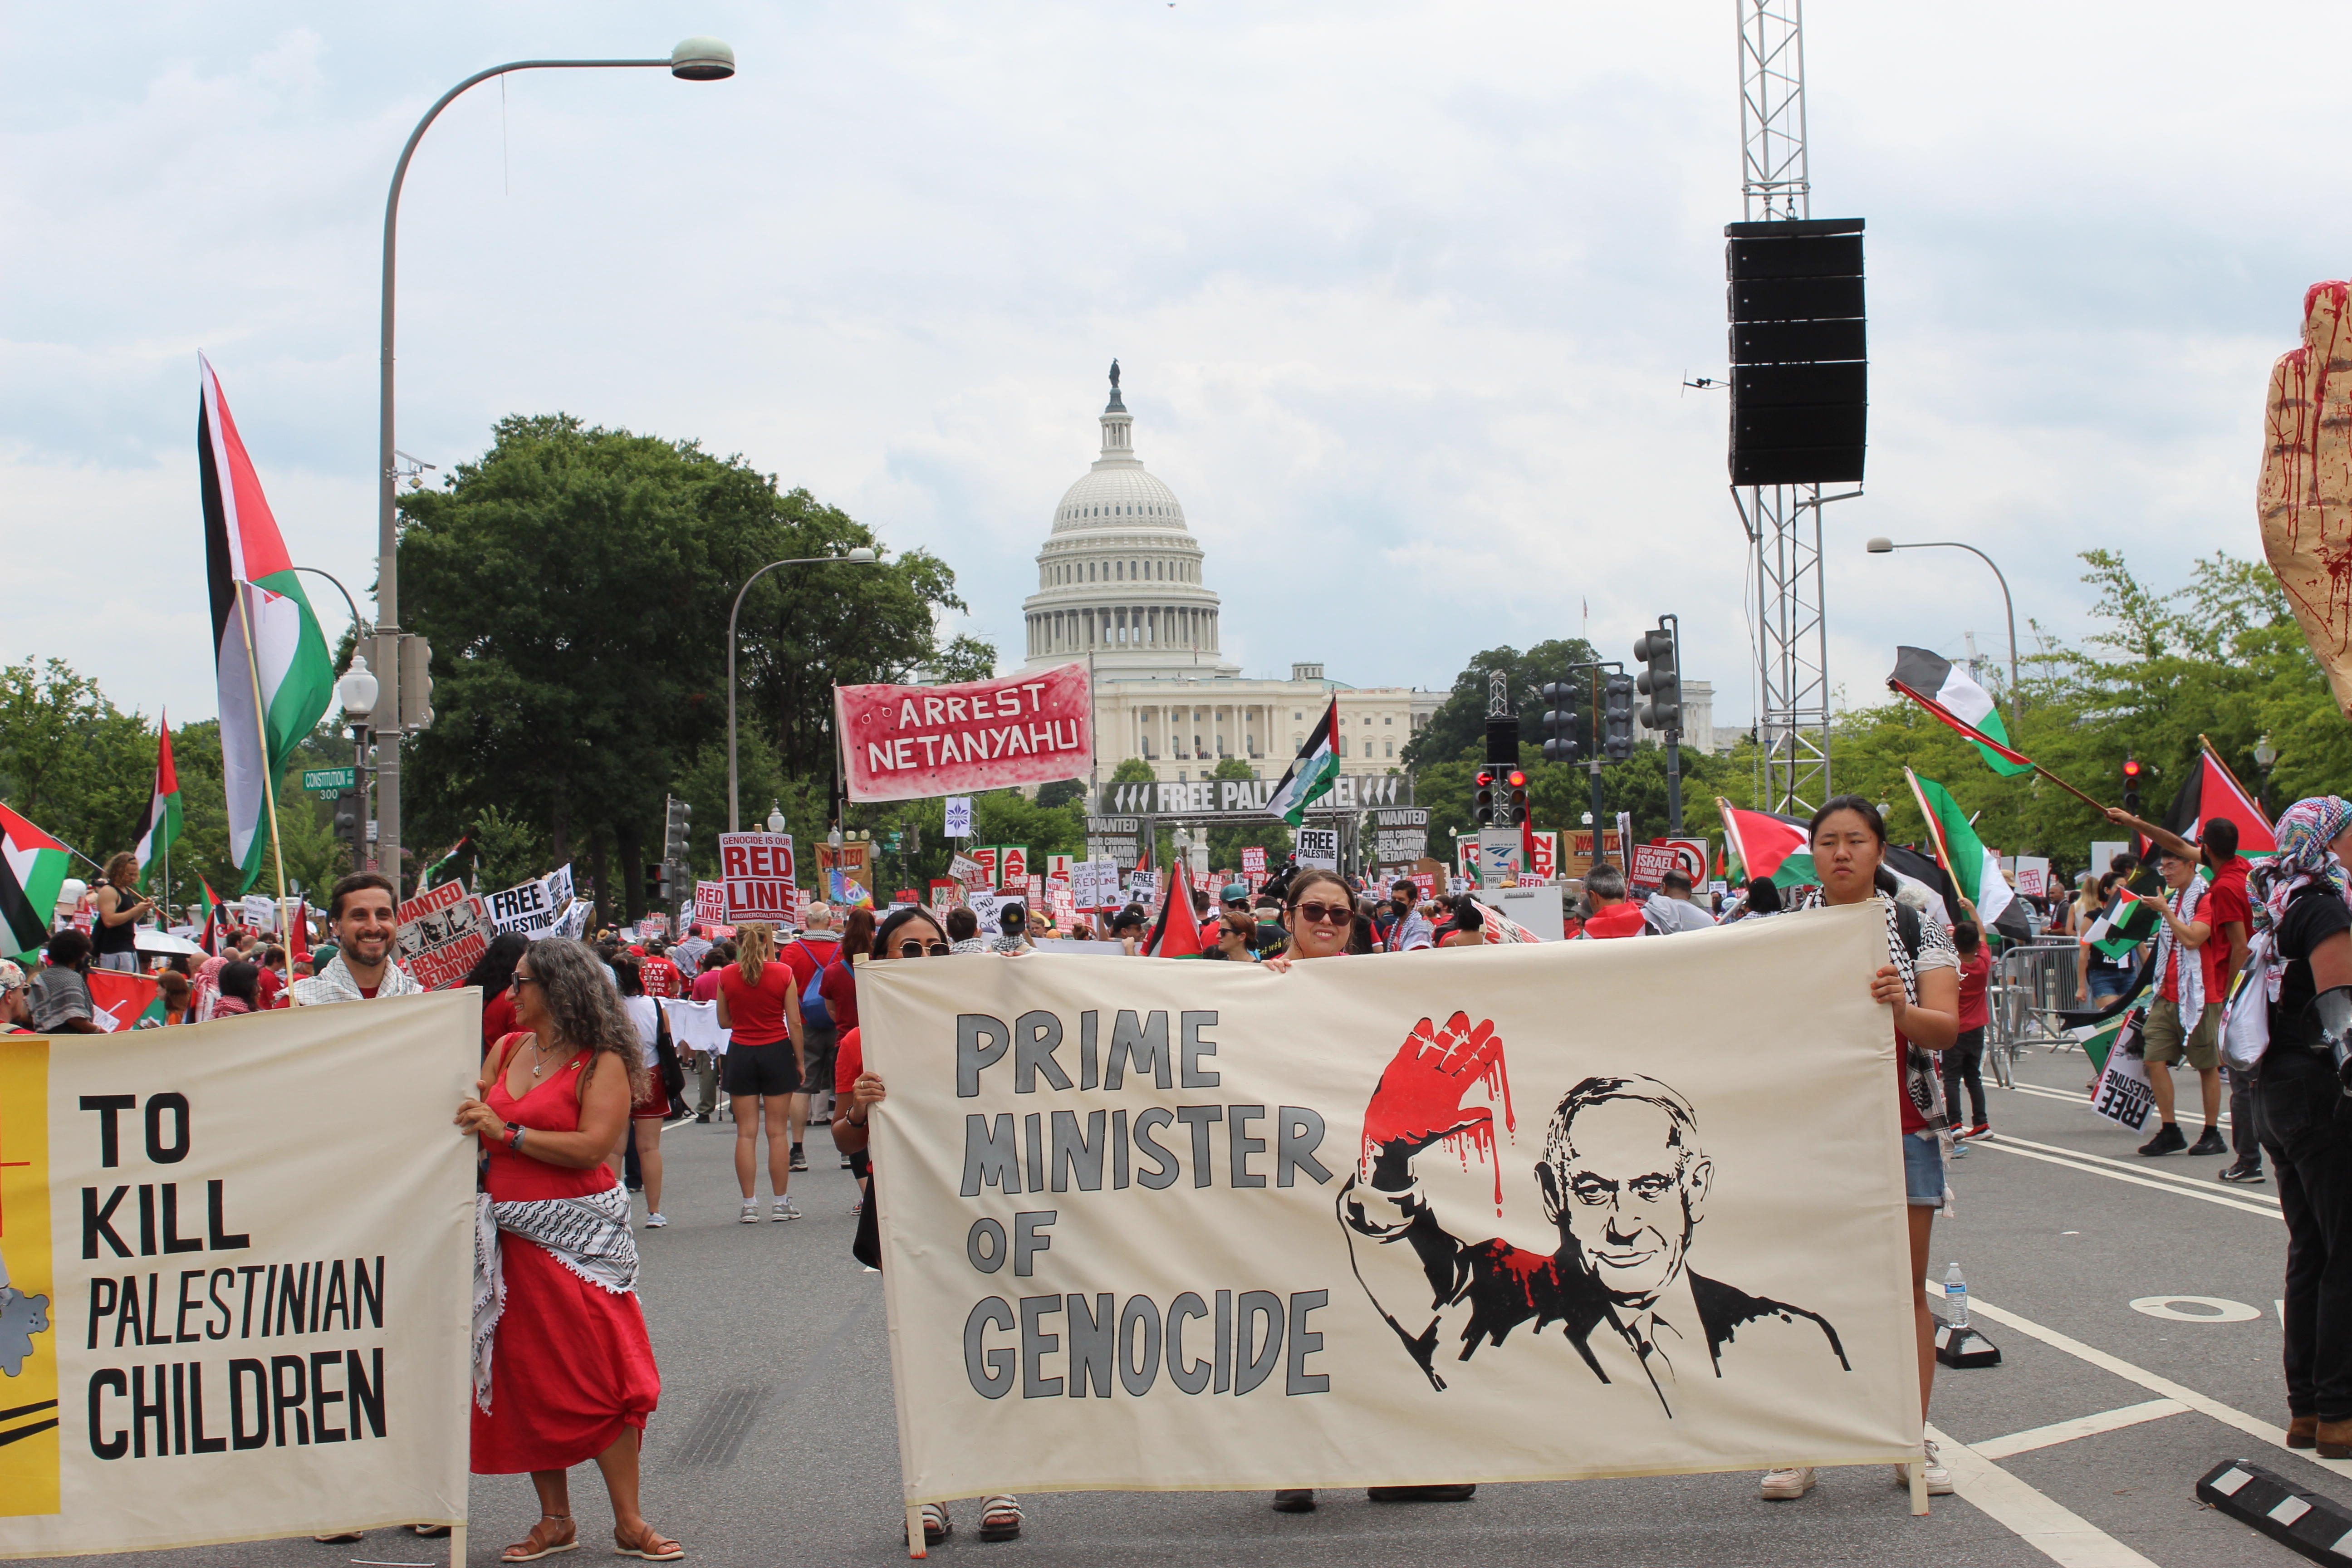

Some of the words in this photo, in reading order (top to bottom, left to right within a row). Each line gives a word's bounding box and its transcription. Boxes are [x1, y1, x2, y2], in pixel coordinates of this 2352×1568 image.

[899, 683, 1045, 730] ARREST
[868, 718, 1079, 773] NETANYAHU
[305, 771, 346, 788] CONSTITUTION
[319, 789, 338, 800] 300
[1157, 782, 1215, 812] FREE
[1377, 810, 1427, 826] WANTED
[1087, 818, 1138, 833] WANTED
[1301, 831, 1333, 850] FREE
[1378, 830, 1394, 839] WAR
[1395, 829, 1426, 839] CRIMINAL
[723, 836, 763, 845] GENOCIDE
[775, 837, 790, 847] OUR
[1104, 837, 1137, 846] CRIMINAL
[1378, 839, 1426, 852] BENJAMIN
[1298, 848, 1335, 859] PALESTINE
[1378, 850, 1425, 862] NETANYAHU
[1653, 849, 1676, 858] ARMING
[724, 846, 792, 877] RED
[1243, 858, 1264, 867] GAZA
[1636, 854, 1673, 870] ISRAEL
[1133, 872, 1154, 883] FREE
[1195, 872, 1209, 882] END
[1210, 874, 1223, 884] ALL
[1633, 874, 1662, 883] COMMUNIT
[1640, 867, 1657, 876] FUND
[547, 872, 561, 892] WITH
[1014, 876, 1028, 884] END
[1029, 875, 1042, 883] ALL
[1074, 877, 1097, 888] RED
[1099, 877, 1117, 885] LINE
[1194, 881, 1207, 891] U.S.
[1208, 882, 1222, 892] AID
[1519, 878, 1543, 887] RED
[1029, 883, 1042, 892] AID
[246, 898, 257, 906] Free,
[493, 883, 544, 920] FREE
[697, 887, 724, 904] RED
[727, 882, 794, 913] LINE
[1054, 891, 1071, 900] END
[1075, 896, 1092, 907] WE
[937, 904, 950, 912] END
[975, 897, 994, 912] END
[1054, 899, 1071, 909] U.S.
[245, 907, 269, 916] Palestine!
[696, 904, 722, 921] LINE
[731, 913, 793, 921] ANSWERCOALITION.ORG
[936, 912, 947, 920] U.S
[985, 907, 1000, 918] the
[1066, 910, 1085, 921] ISRAEL
[493, 910, 554, 936] PALESTINE
[640, 922, 654, 931] RED
[407, 946, 431, 960] WAR
[431, 926, 479, 951] CRIMINAL
[410, 931, 486, 977] BENJAMIN
[2323, 1028, 2334, 1043] PYLE
[957, 1009, 1220, 1098] PRIME
[2105, 1068, 2156, 1106] PALESTINE
[2097, 1084, 2151, 1131] FREE
[79, 1093, 191, 1167] TO
[960, 1105, 1334, 1196] MINISTER
[82, 1180, 250, 1259] KILL
[967, 1210, 1057, 1276] OF
[87, 1255, 385, 1350] PALESTINIAN
[964, 1289, 1330, 1399] GENOCIDE
[88, 1347, 387, 1460] CHILDREN
